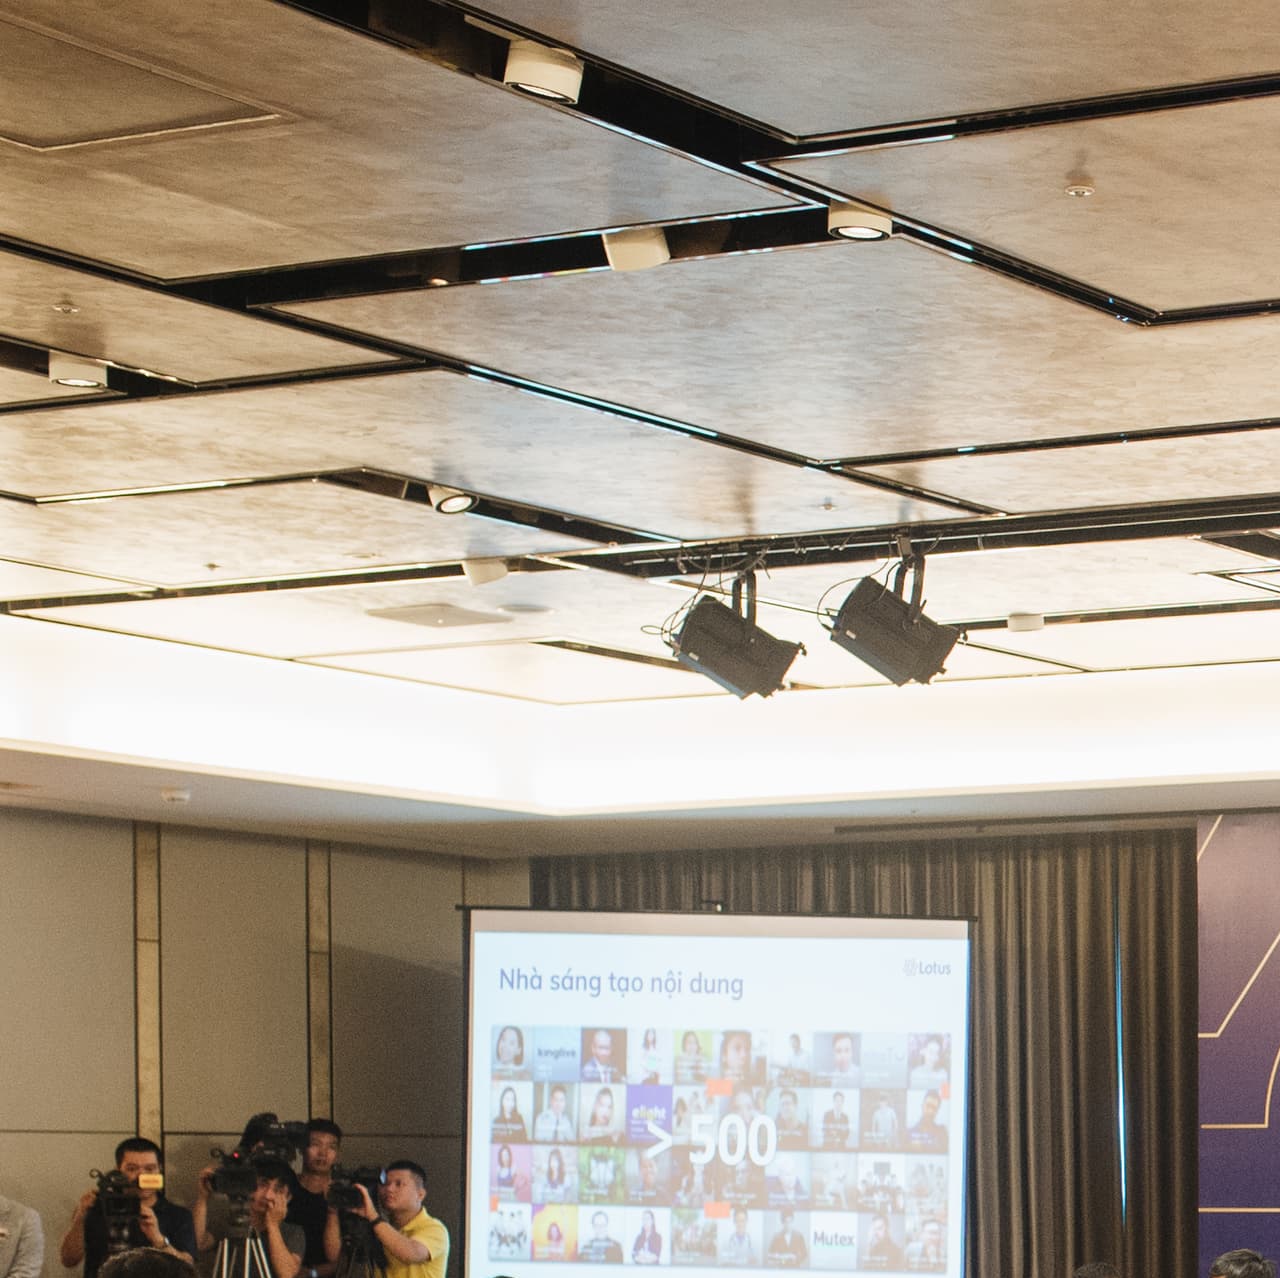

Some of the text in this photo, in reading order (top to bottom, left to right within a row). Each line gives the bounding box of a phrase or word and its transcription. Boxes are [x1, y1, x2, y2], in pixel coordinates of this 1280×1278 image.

[919, 960, 951, 976] Lotus
[499, 968, 743, 1000] Nhà sáng tạo nội dung
[688, 1114, 777, 1166] 500
[813, 1230, 855, 1247] Mutex
